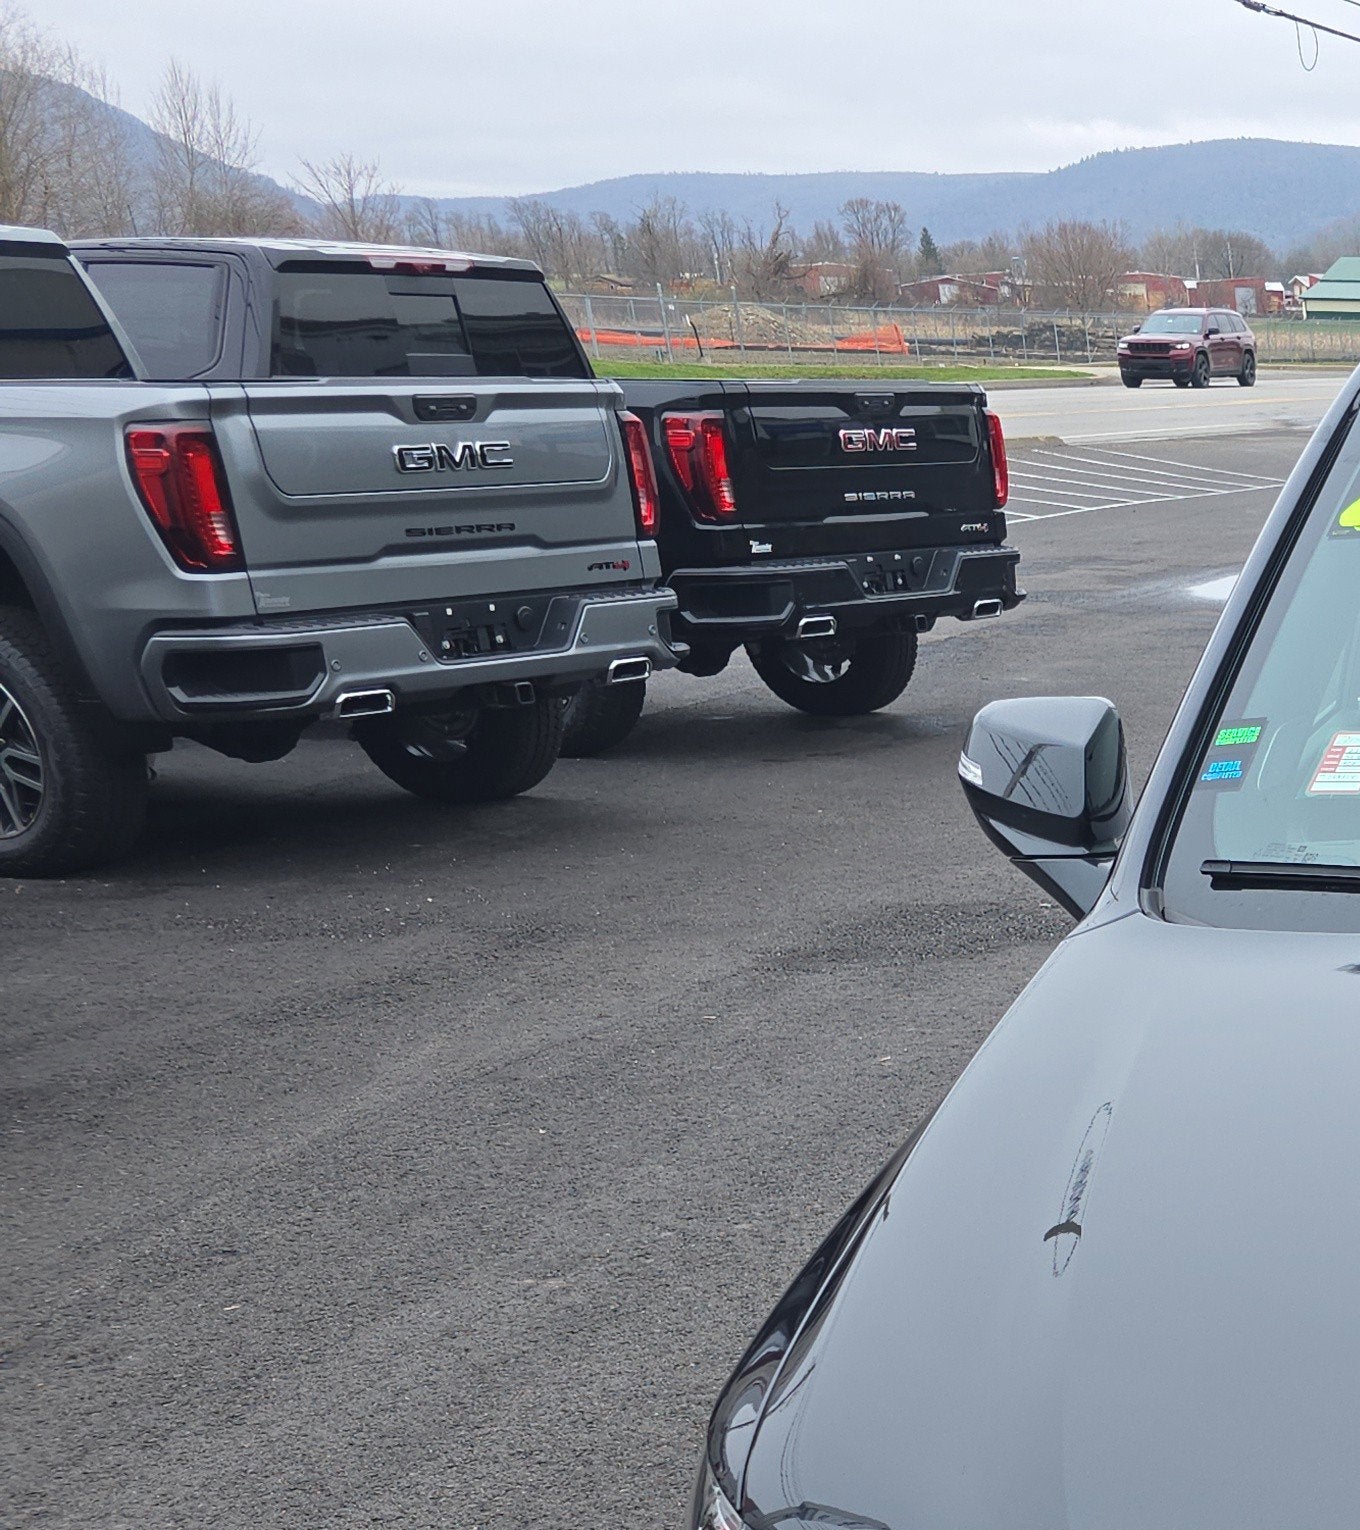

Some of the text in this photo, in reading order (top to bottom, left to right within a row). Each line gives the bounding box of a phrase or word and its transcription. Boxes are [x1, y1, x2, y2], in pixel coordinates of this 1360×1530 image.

[839, 428, 917, 452] GMC
[393, 440, 514, 473] GMC
[844, 491, 916, 501] SIERRA
[405, 522, 516, 537] SIERRA
[587, 559, 630, 572] AT4
